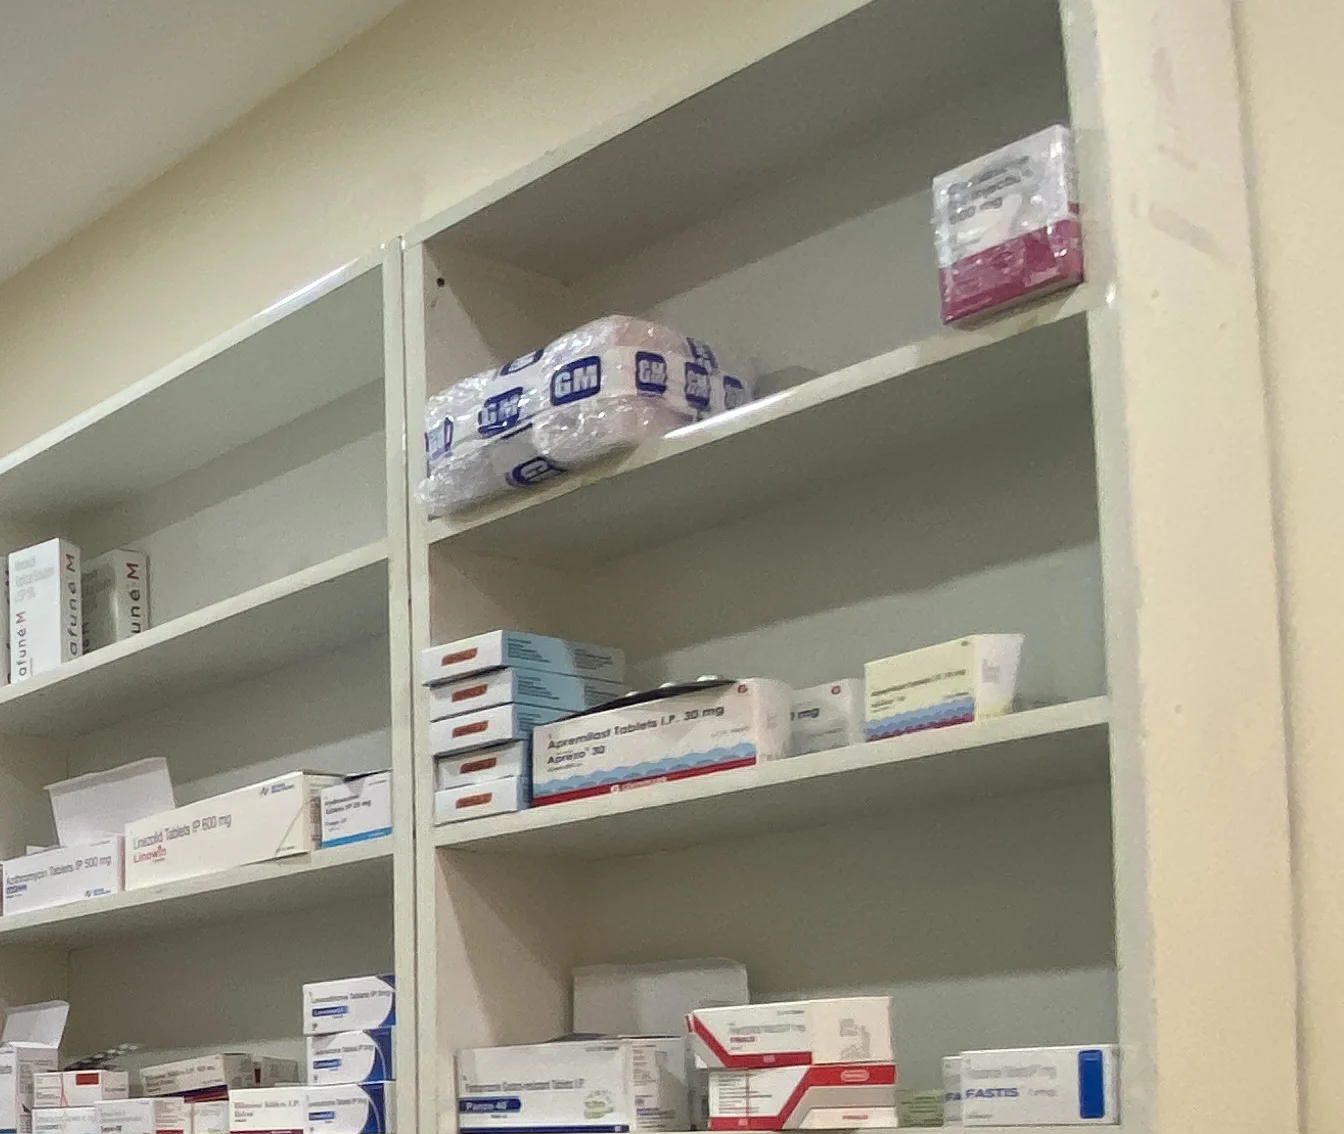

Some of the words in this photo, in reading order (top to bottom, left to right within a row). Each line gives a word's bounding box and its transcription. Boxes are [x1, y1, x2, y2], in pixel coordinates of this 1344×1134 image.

[552, 359, 600, 398] GM
[126, 562, 140, 580] M
[547, 728, 611, 751] Apremilast
[614, 718, 658, 737] Tablets
[701, 704, 725, 719] mg
[164, 821, 191, 841] Tablets
[218, 812, 232, 828] mg
[99, 855, 112, 867] mg
[965, 1088, 1019, 1099] FASTIS
